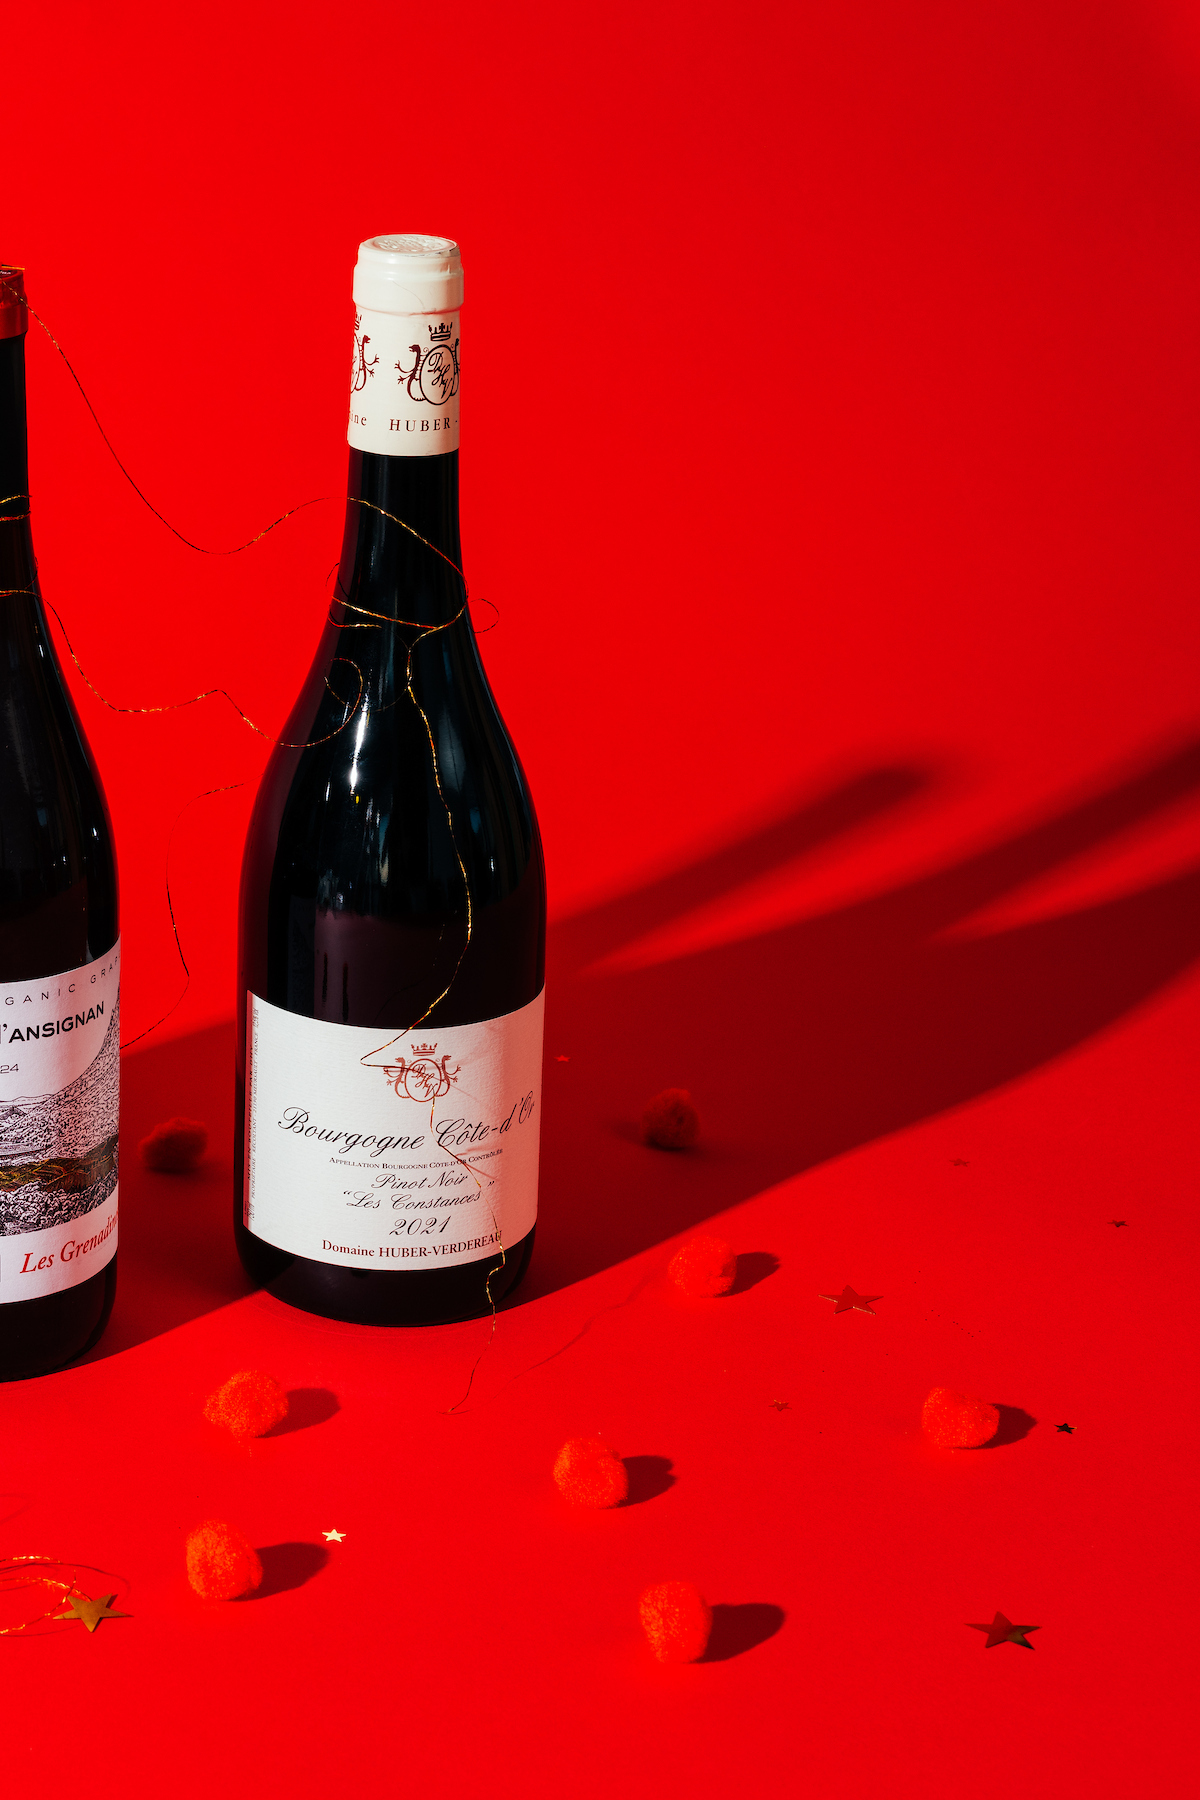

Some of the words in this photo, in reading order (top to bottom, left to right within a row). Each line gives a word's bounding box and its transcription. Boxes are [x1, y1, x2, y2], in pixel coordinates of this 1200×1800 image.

[278, 1106, 425, 1158] Bourgogne
[371, 1173, 428, 1190] Pinot
[428, 1170, 468, 1189] Noir
[388, 1215, 452, 1236] 2021
[322, 1239, 375, 1257] Domaine
[378, 1230, 503, 1258] HUBER-VERDEREAU
[19, 1252, 55, 1274] Les
